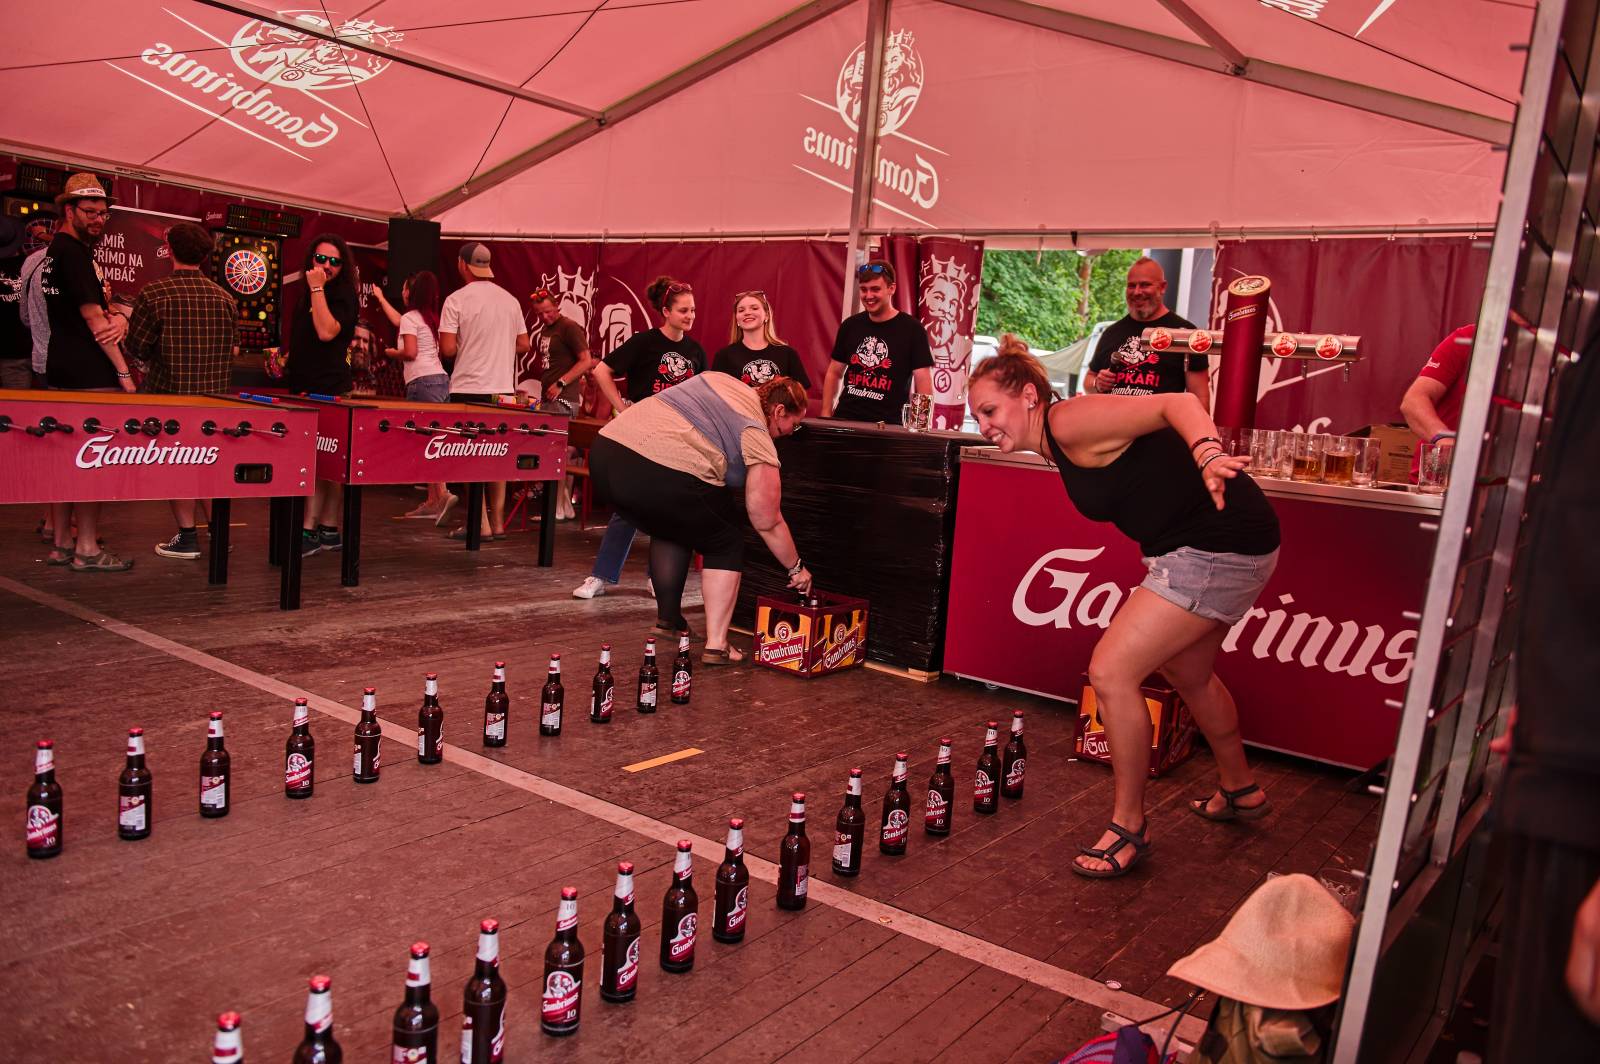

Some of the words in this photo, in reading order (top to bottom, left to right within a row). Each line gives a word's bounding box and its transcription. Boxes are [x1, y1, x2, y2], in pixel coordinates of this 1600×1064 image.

[129, 253, 144, 268] NA
[1115, 370, 1161, 388] PKAŘI
[75, 434, 219, 469] Gambrinus
[424, 434, 509, 460] Gambrinus
[1011, 546, 1420, 685] Garinus
[762, 643, 803, 662] Gambrinus
[824, 636, 856, 669] Gambrinus
[566, 1010, 577, 1020] 10
